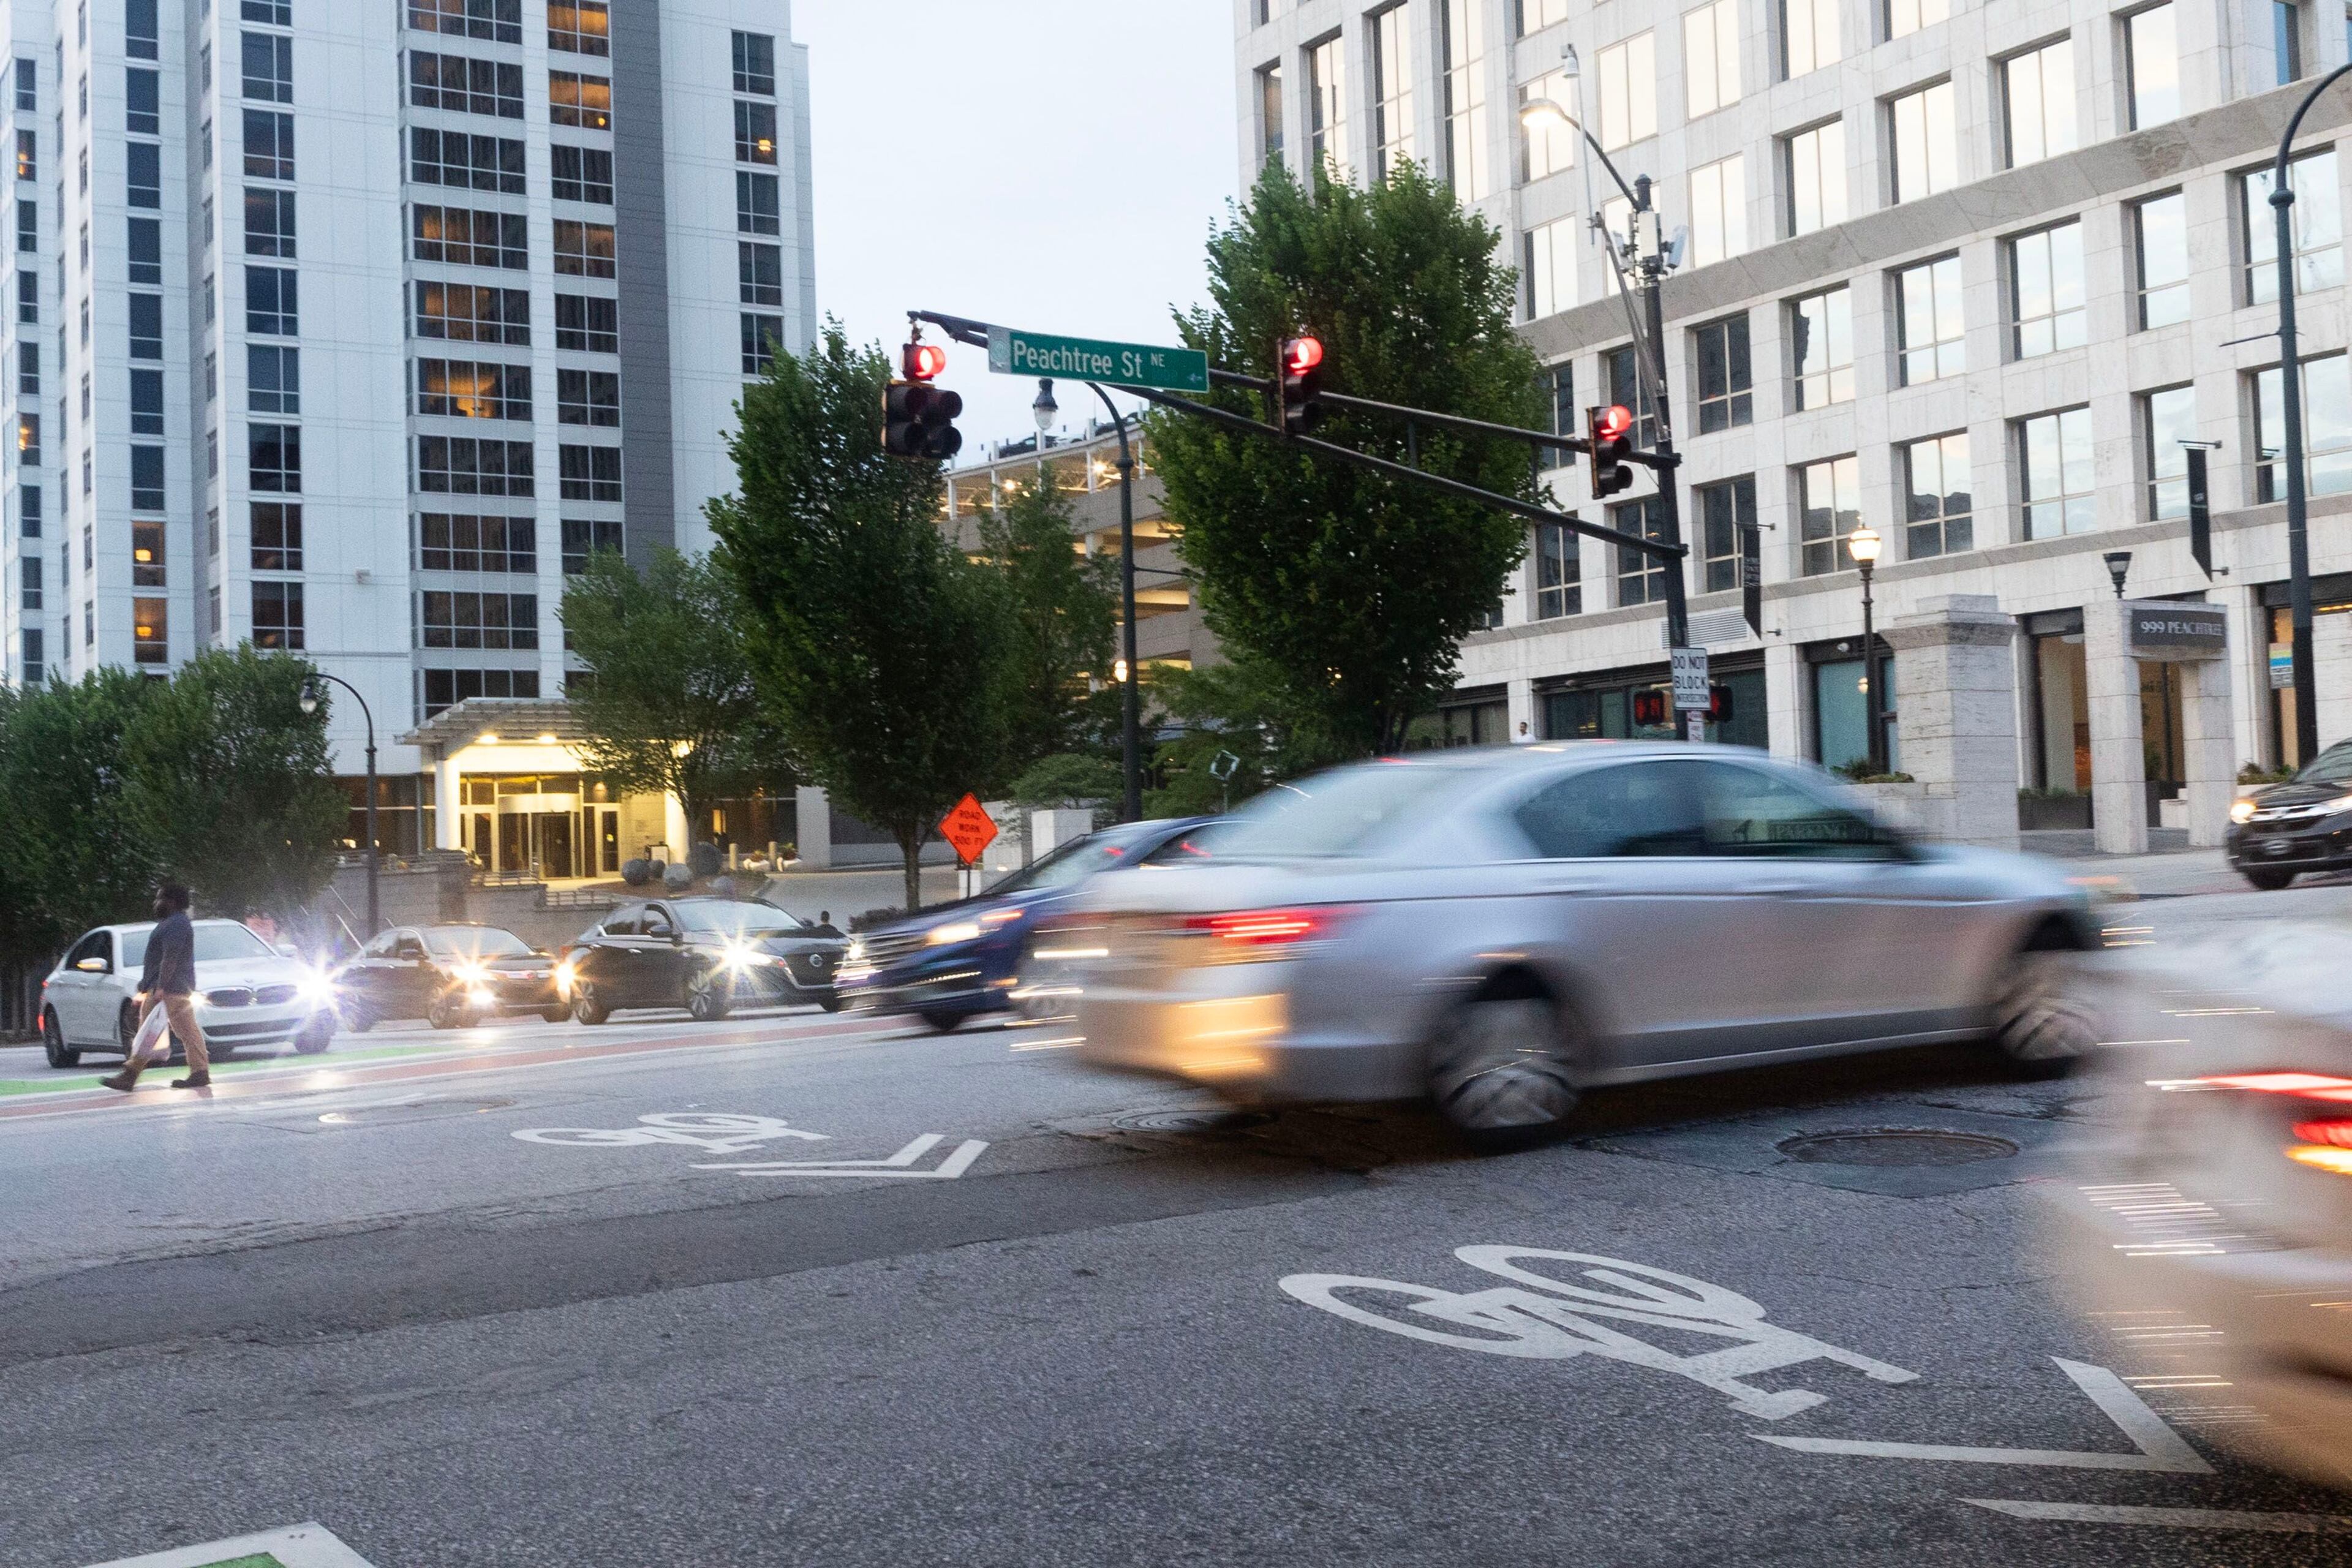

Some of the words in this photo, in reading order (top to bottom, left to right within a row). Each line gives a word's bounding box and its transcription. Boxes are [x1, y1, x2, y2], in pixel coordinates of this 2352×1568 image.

[1013, 339, 1113, 375] Peachtree
[1121, 350, 1143, 379] St
[1150, 352, 1166, 368] NE
[2140, 621, 2166, 633] 999
[2167, 621, 2223, 636] PEACHTREE
[1673, 656, 1686, 669] DO
[1688, 656, 1706, 669] NOT
[1673, 676, 1708, 689] BLOCK
[959, 810, 981, 820] ROAD
[959, 823, 980, 832] WORK
